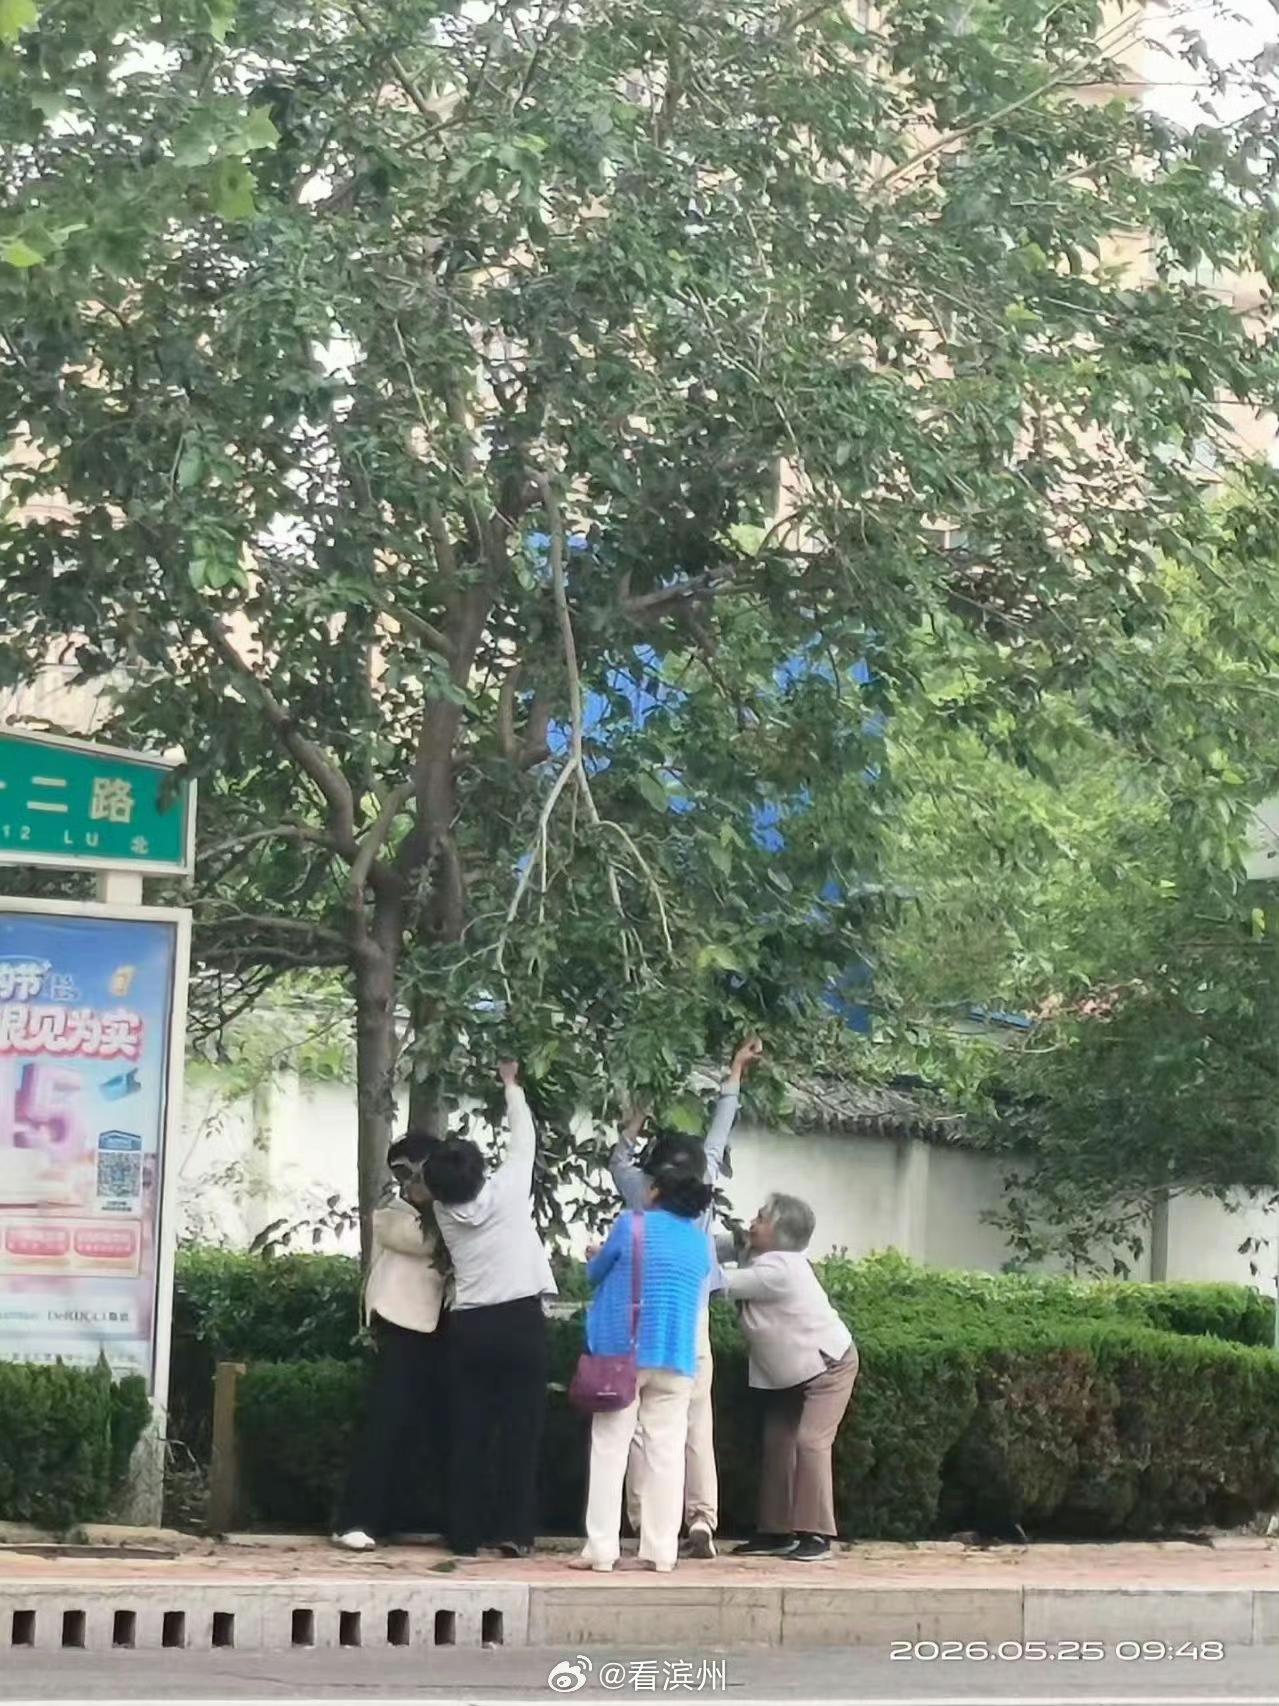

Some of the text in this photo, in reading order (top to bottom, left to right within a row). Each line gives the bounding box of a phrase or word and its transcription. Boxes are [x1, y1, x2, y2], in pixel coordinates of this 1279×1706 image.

[0, 777, 135, 824] 二路
[2, 825, 99, 847] 12 LU
[0, 1003, 142, 1060] 眼见为实
